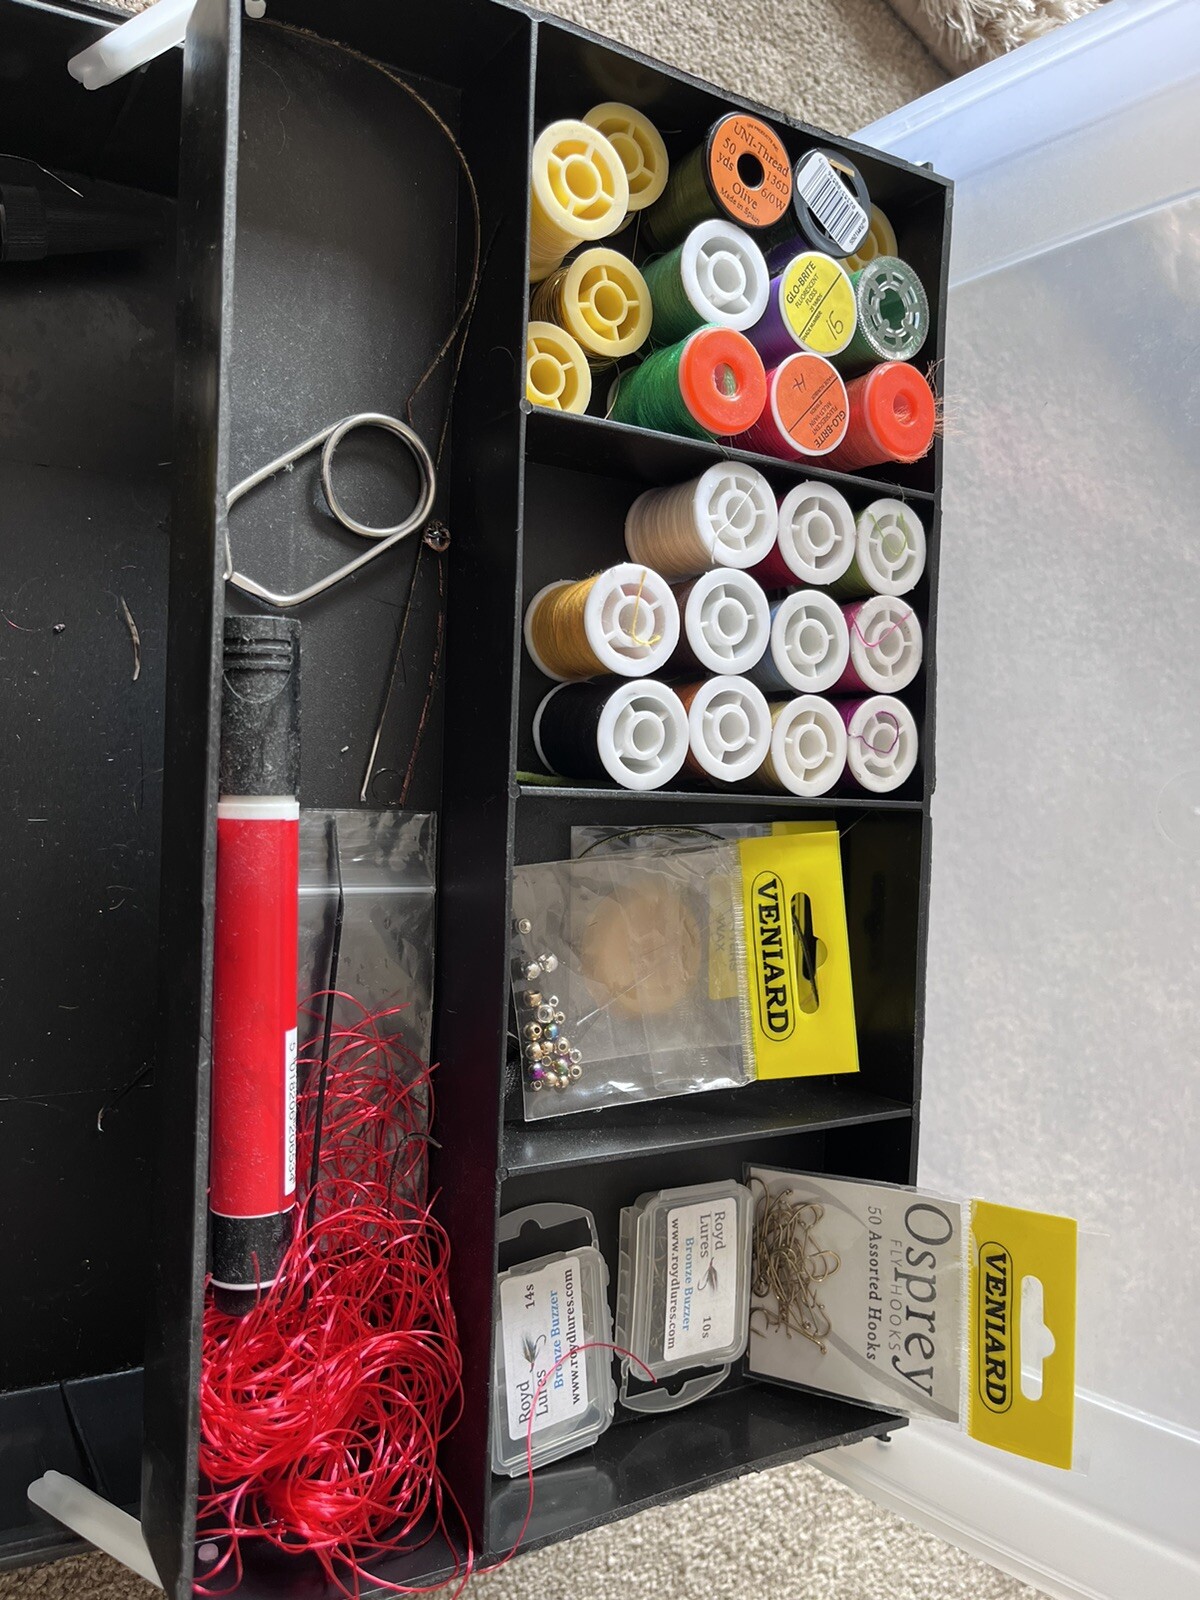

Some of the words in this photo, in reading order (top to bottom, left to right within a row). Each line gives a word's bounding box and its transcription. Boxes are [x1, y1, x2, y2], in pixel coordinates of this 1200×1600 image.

[716, 152, 734, 172] yds
[722, 137, 736, 155] 50
[734, 121, 790, 178] UNI-Thread
[720, 187, 737, 206] Made
[732, 182, 758, 210] Olive
[761, 188, 787, 212] 6/0W
[766, 171, 790, 196] 136D
[786, 260, 816, 304] GLO-BRITE
[795, 273, 820, 309] FLUORESCENT
[805, 289, 818, 306] FLOSS
[826, 310, 844, 341] 16
[812, 406, 838, 436] FLUORESCENT
[813, 410, 847, 449] GLO-BRITE
[758, 878, 789, 1033] VENIARD
[700, 1214, 711, 1259] Lures
[711, 1211, 727, 1251] Royd
[868, 1206, 882, 1226] 50
[684, 1237, 695, 1284] Bronze
[868, 1230, 883, 1305] Assorted
[890, 1239, 903, 1267] FLY
[525, 1283, 535, 1310] 14s
[667, 1218, 681, 1350] www.roydlures.com
[891, 1203, 953, 1398] Osprey
[550, 1290, 562, 1338] Buzzer
[682, 1286, 694, 1331] Buzzer
[702, 1316, 712, 1339] 10s
[888, 1284, 902, 1351] HOOKS
[985, 1252, 1007, 1406] VENIARD
[564, 1268, 581, 1405] www.roydlures.com
[866, 1307, 882, 1361] Hooks
[552, 1340, 564, 1390] Bronze
[516, 1380, 532, 1425] Royd
